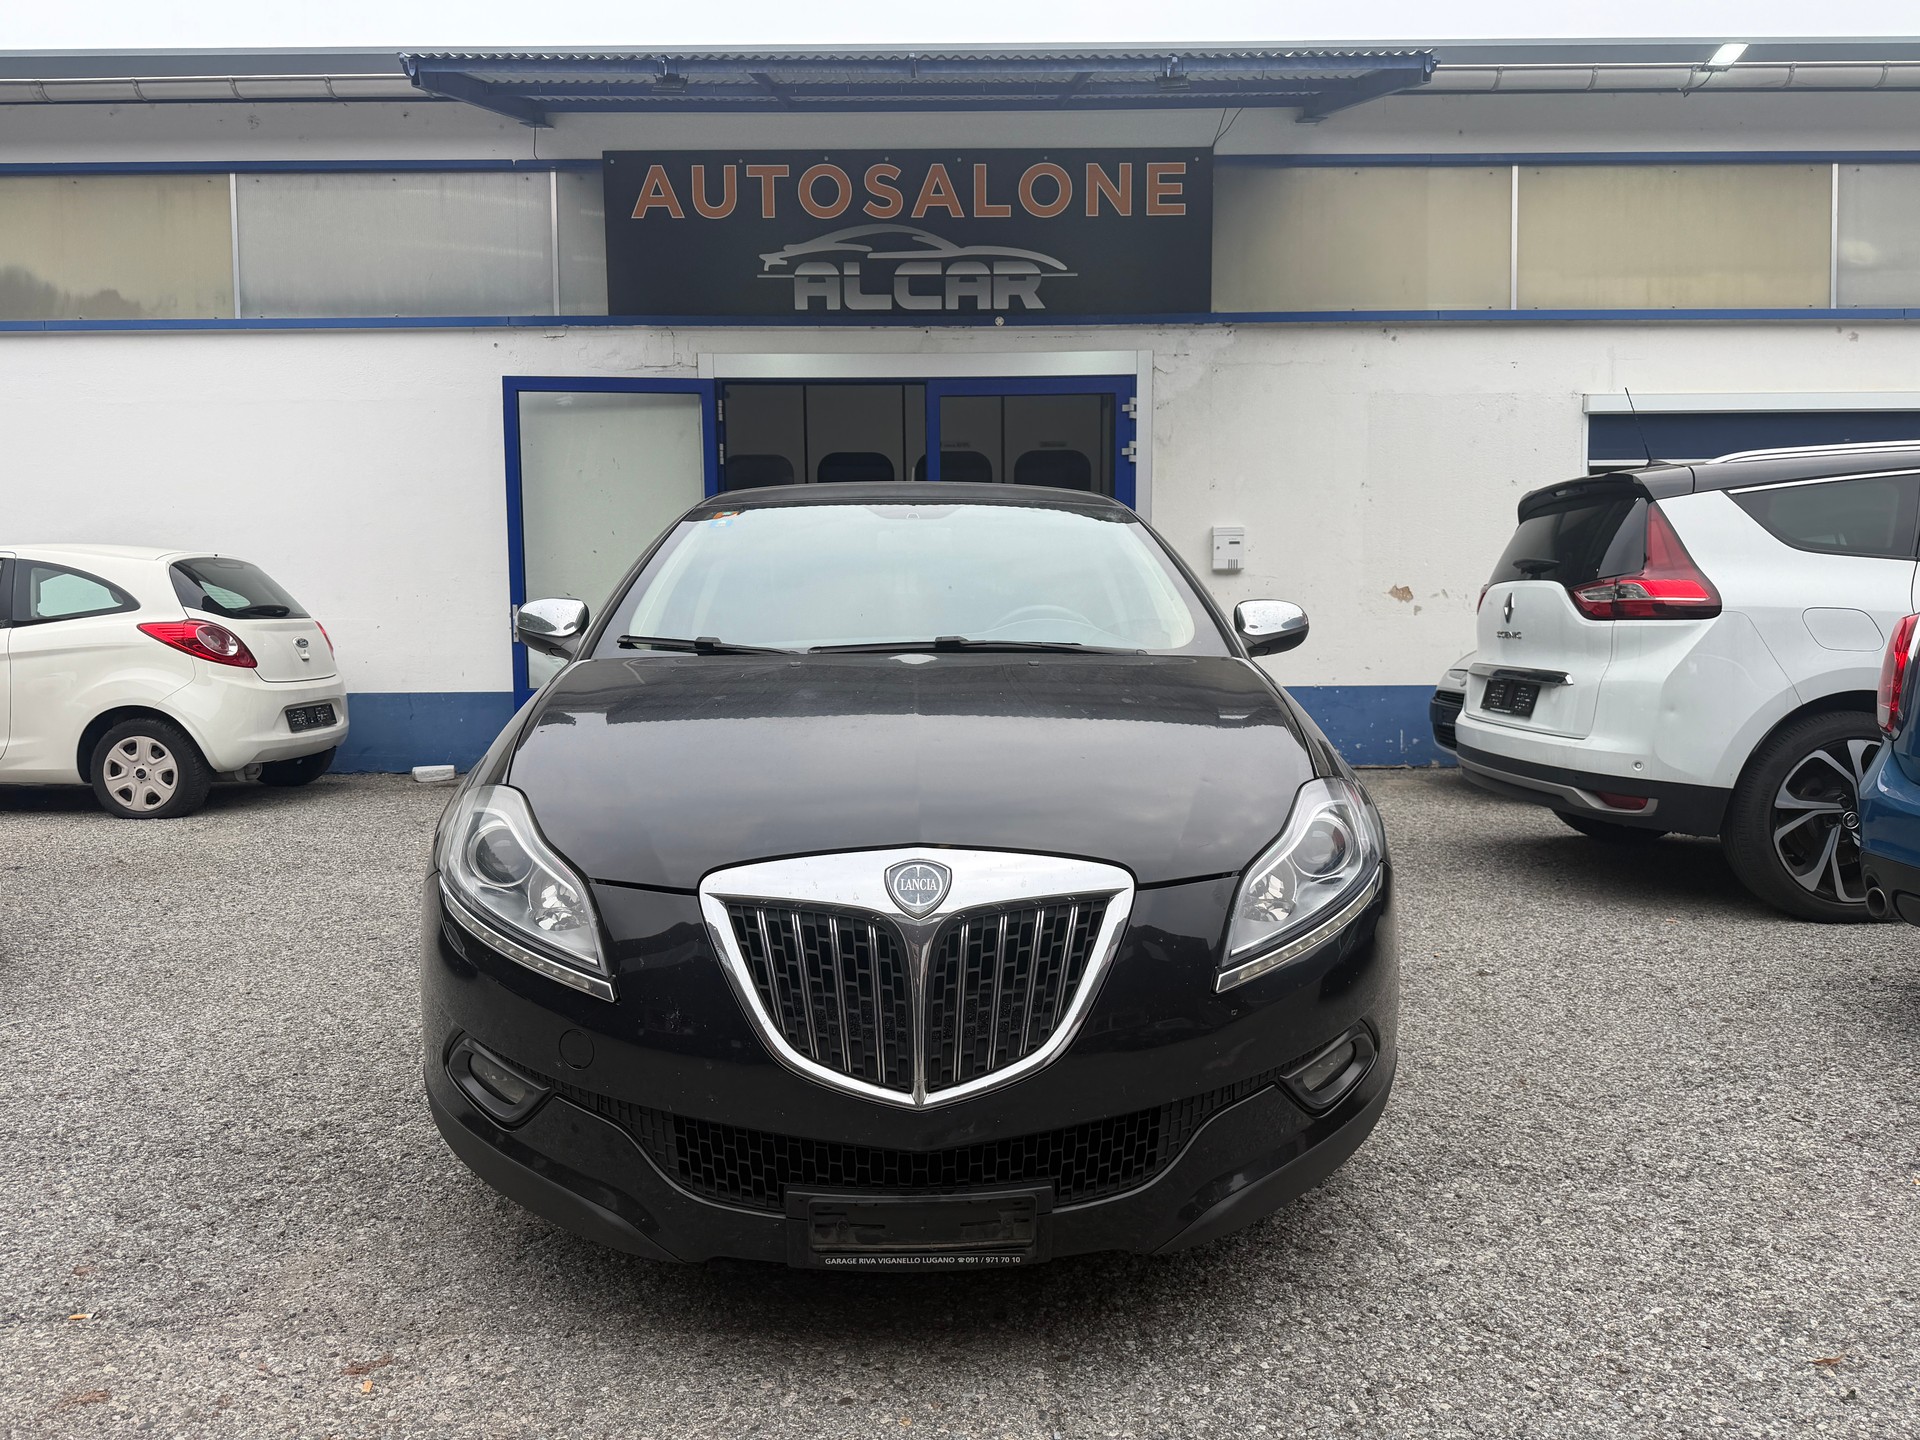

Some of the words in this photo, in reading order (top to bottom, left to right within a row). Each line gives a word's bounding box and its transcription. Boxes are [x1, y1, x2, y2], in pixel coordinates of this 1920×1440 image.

[631, 162, 1186, 219] AUTOSALONE
[794, 261, 1046, 311] ALCAR
[900, 878, 938, 891] LANCIA
[825, 1257, 857, 1265] GARAGE
[922, 1256, 956, 1264] LUGANO
[965, 1256, 979, 1264] 091
